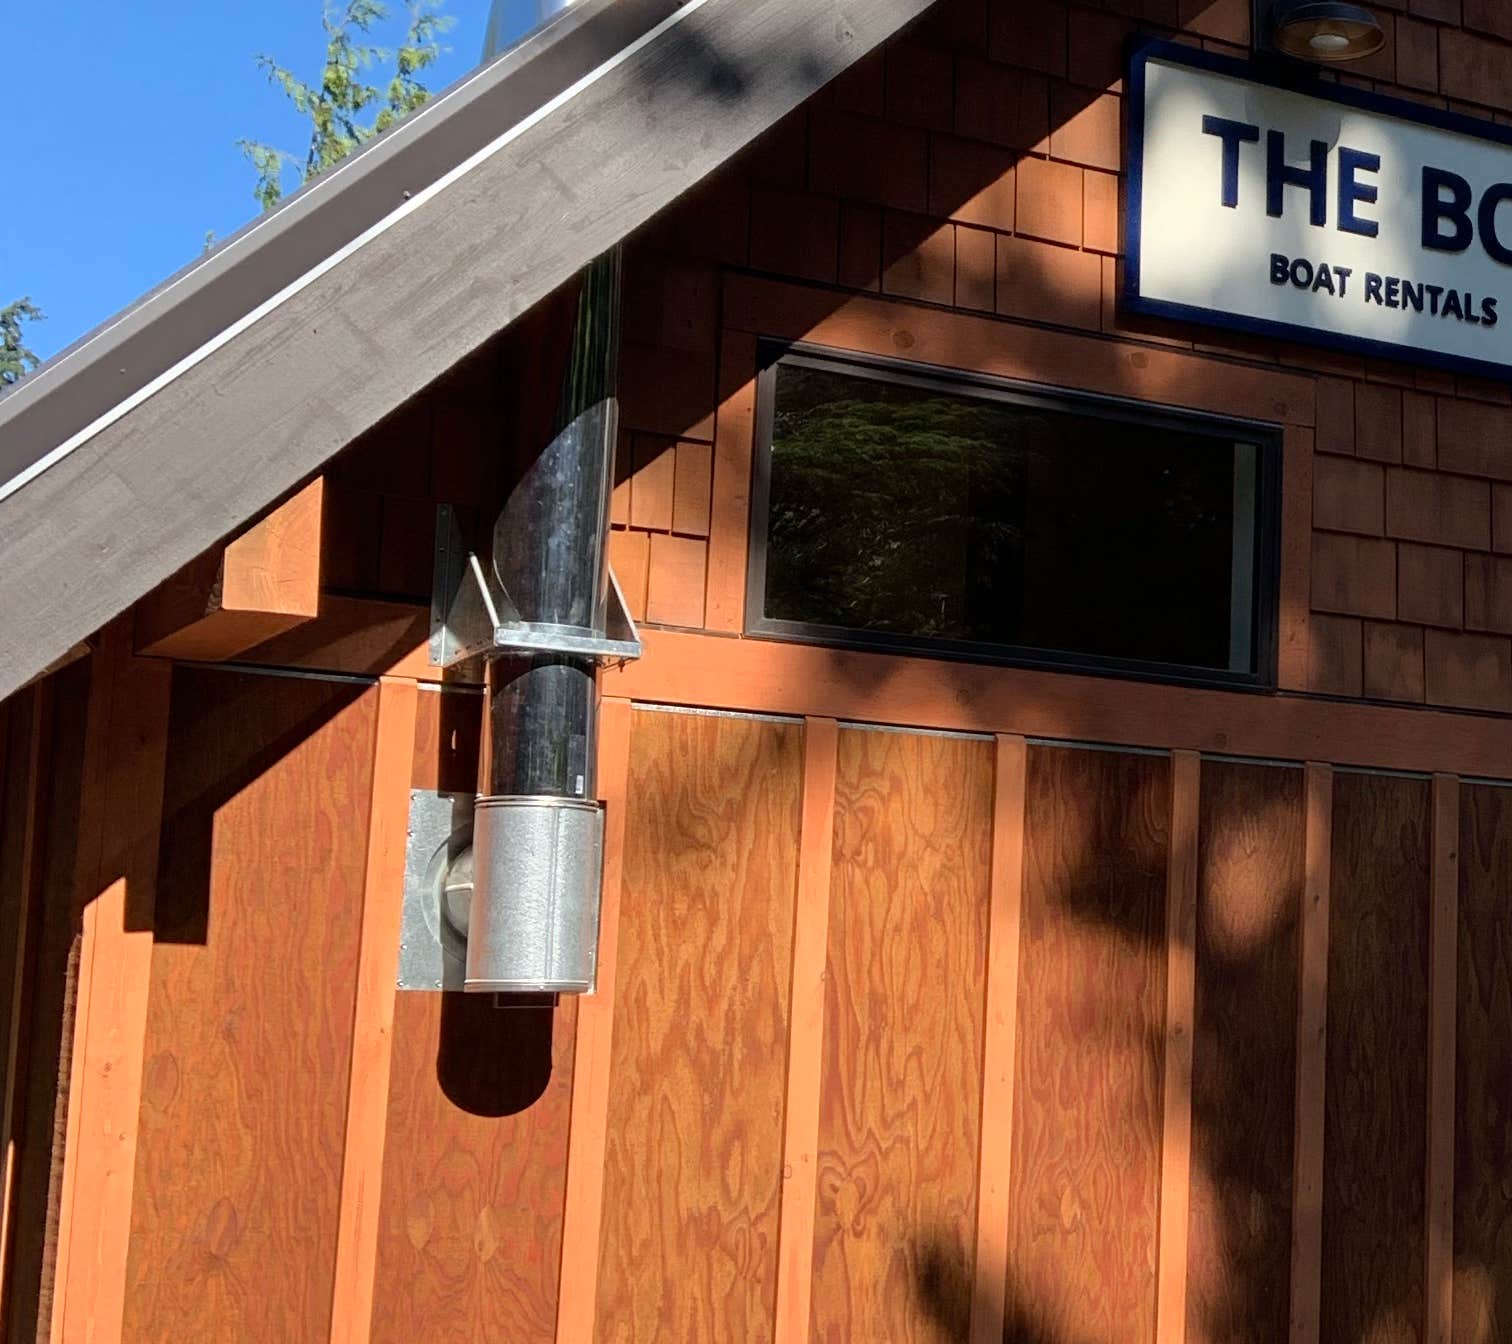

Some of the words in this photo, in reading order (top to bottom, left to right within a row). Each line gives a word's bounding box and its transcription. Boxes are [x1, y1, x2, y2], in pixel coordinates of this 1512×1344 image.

[1201, 115, 1382, 239] THE
[1269, 253, 1352, 298] BOAT
[1364, 272, 1498, 329] RENTALS
